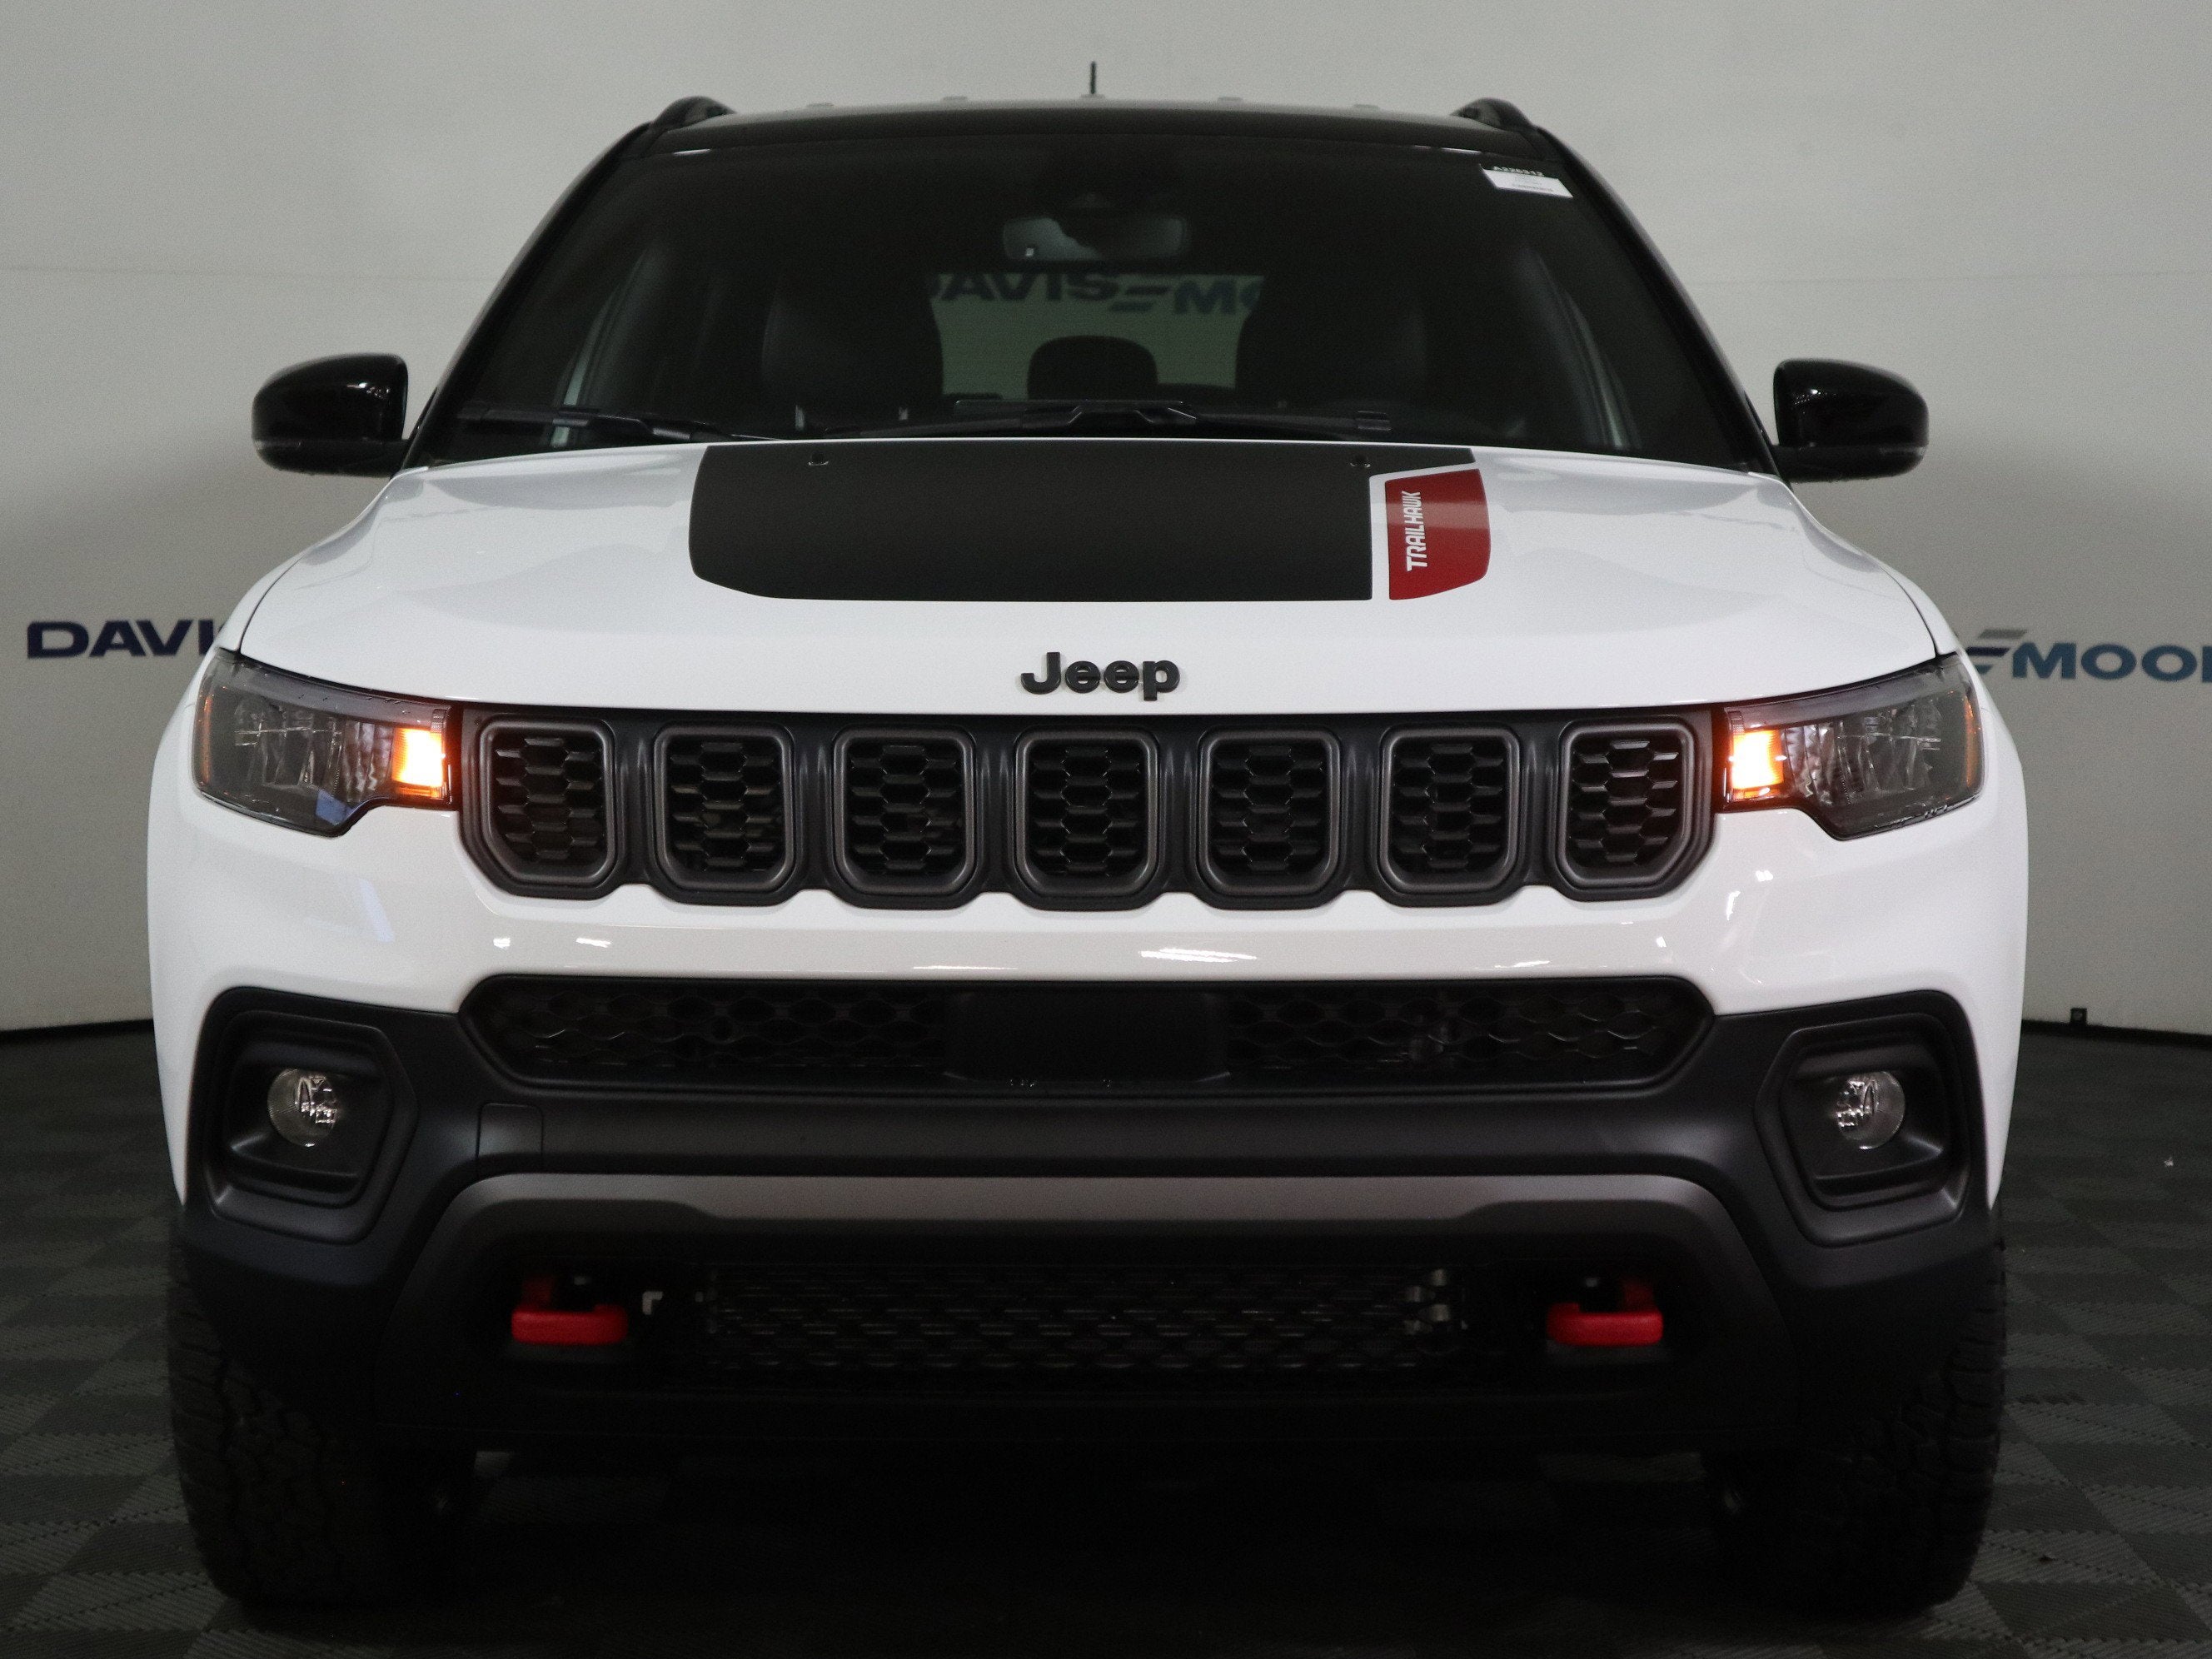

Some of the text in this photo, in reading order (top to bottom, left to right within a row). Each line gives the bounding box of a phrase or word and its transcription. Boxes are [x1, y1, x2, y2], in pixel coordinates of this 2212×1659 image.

[931, 272, 1120, 302] AVIS
[1402, 491, 1428, 572] TRAILHAWK
[27, 619, 222, 659] DAVI
[1021, 651, 1180, 701] Jeep
[2012, 641, 2212, 683] MOO
